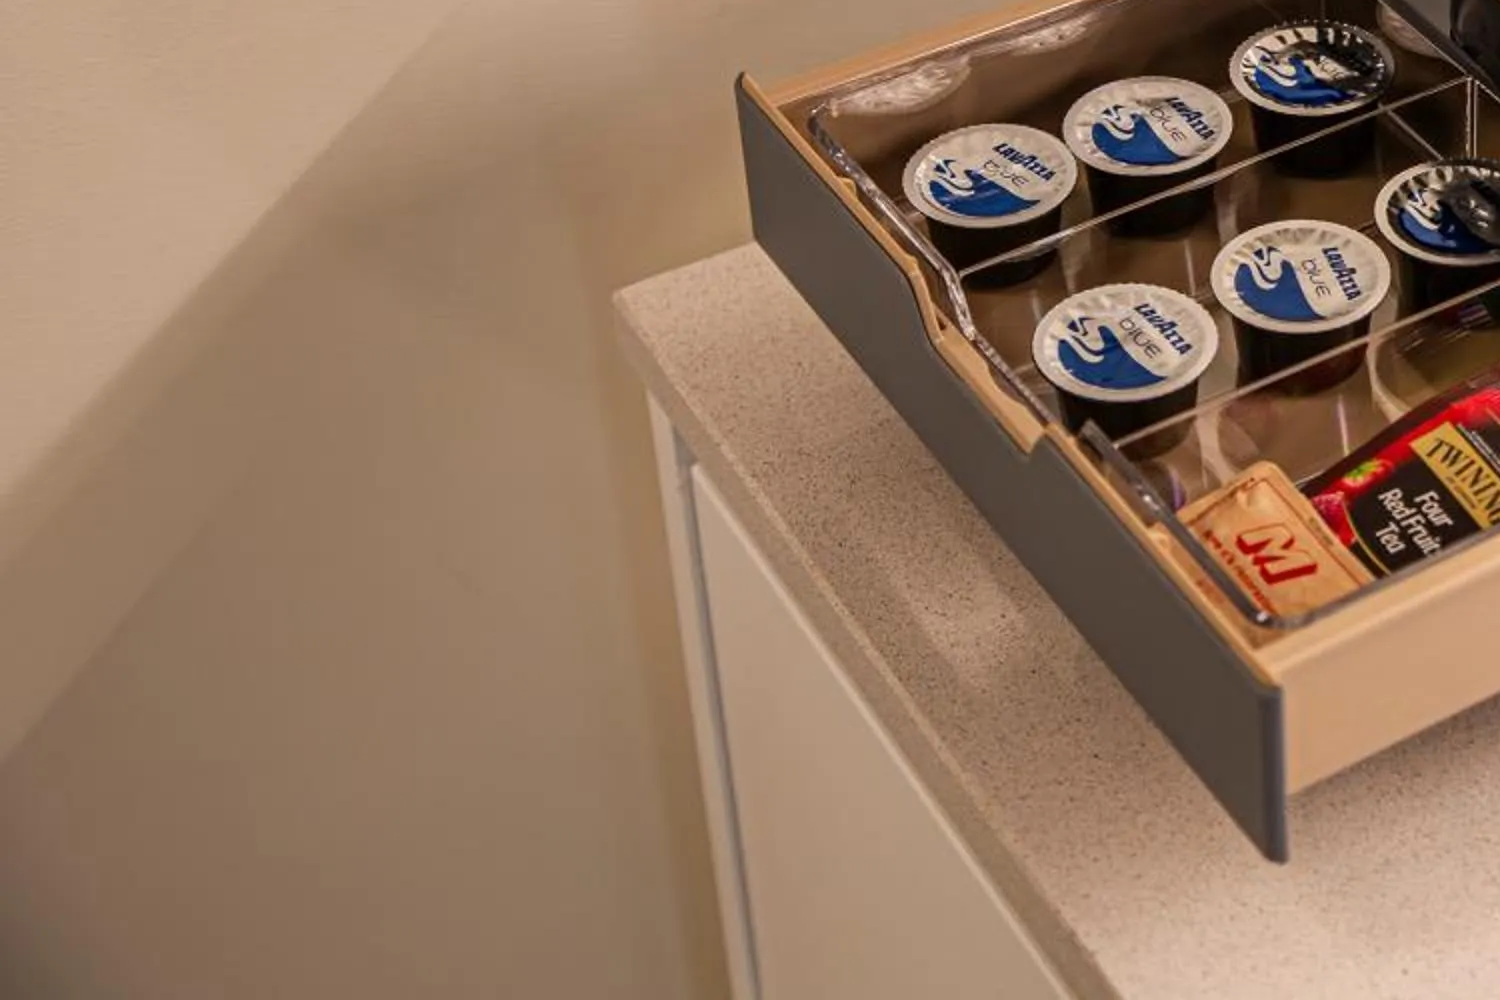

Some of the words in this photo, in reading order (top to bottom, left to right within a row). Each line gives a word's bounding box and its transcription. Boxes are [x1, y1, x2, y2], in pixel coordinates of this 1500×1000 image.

[1165, 97, 1216, 140] LAVAZZA
[992, 142, 1057, 181] LAVAZZA
[1321, 246, 1363, 301] LAVAZZA
[1133, 302, 1194, 355] LAVAZZA
[1377, 486, 1418, 520] Red
[1401, 513, 1442, 556] Fruit
[1413, 489, 1454, 527] Four
[1375, 521, 1407, 556] Tea
